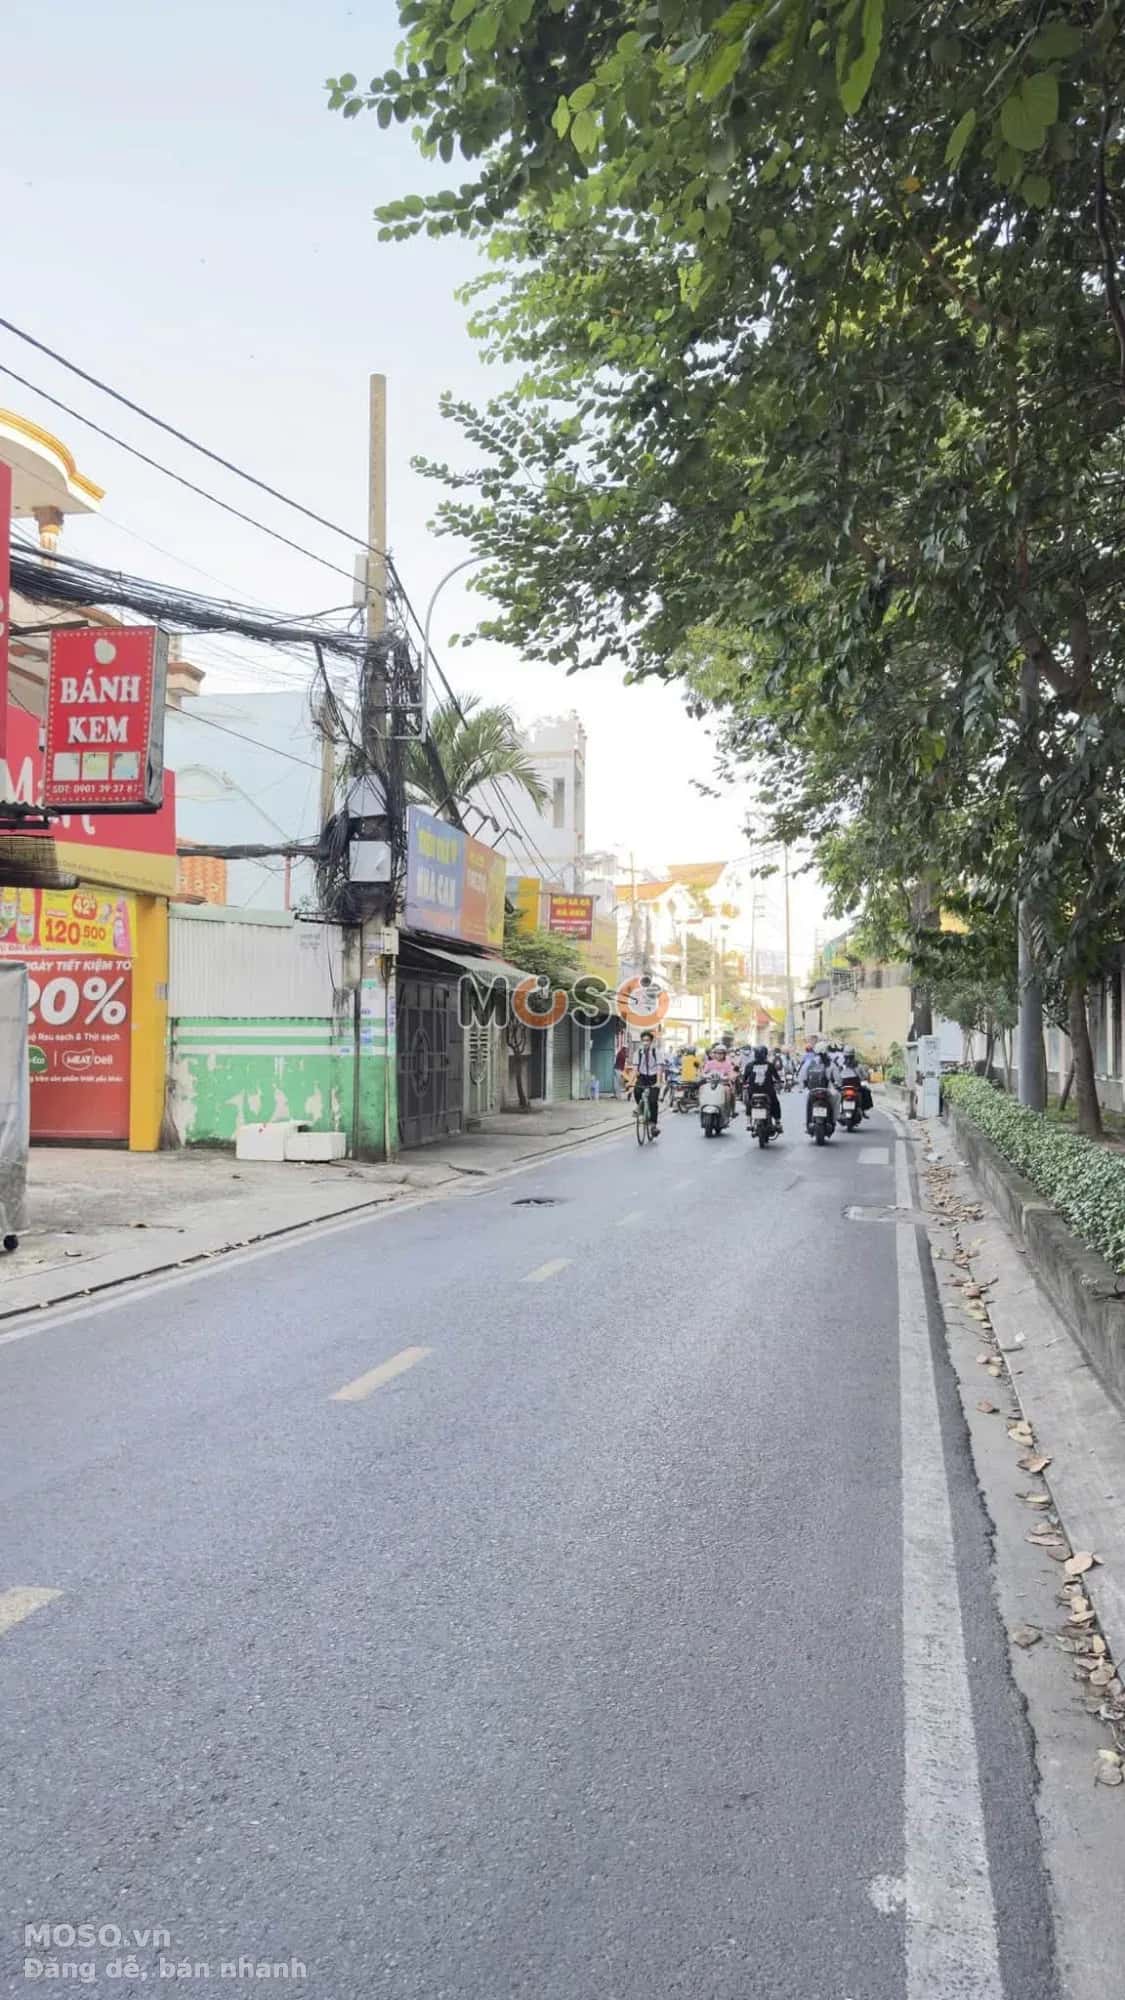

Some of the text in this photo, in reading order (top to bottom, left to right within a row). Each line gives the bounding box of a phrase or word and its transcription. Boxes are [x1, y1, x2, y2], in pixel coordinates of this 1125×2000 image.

[60, 668, 141, 703] BÁNH
[67, 715, 128, 743] KEM
[56, 958, 80, 972] TIẾT
[38, 1033, 54, 1041] Rau
[94, 1054, 113, 1065] Deli
